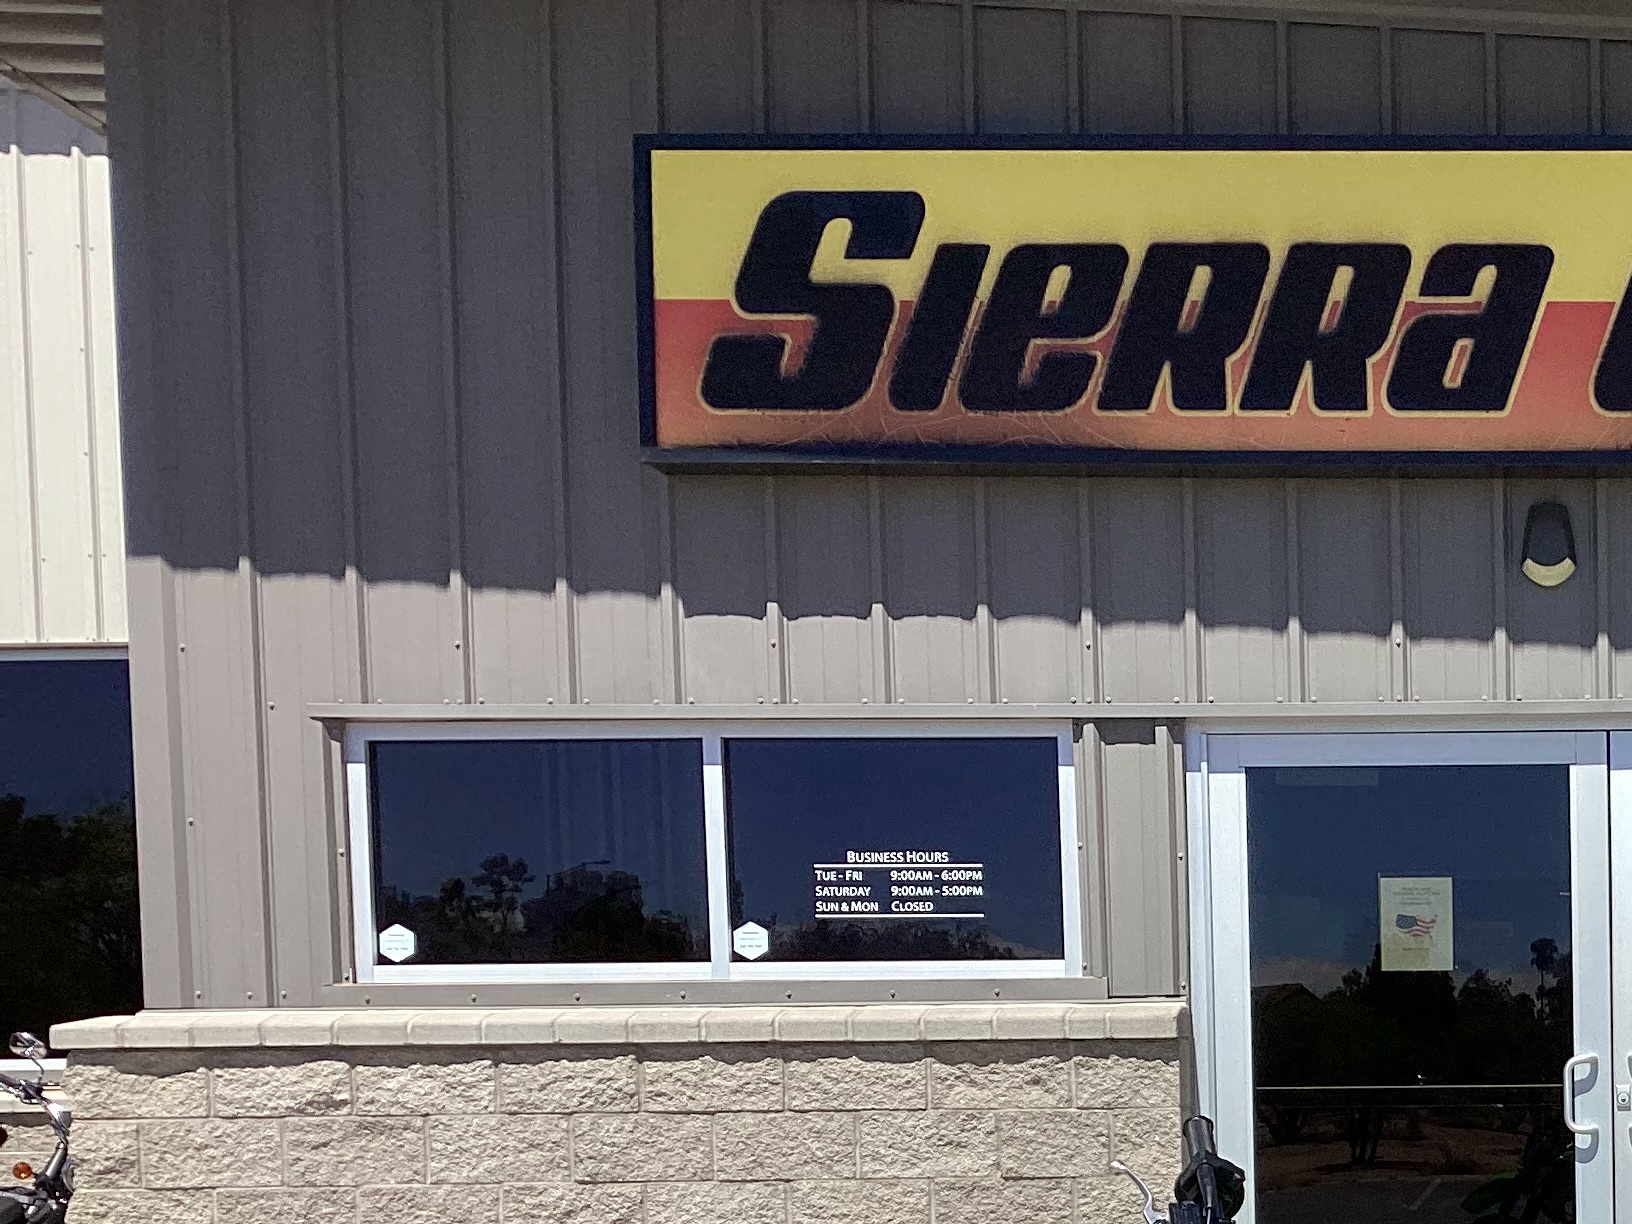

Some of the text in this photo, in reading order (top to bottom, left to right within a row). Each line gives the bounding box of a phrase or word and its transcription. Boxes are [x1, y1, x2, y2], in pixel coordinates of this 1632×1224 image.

[846, 851, 949, 863] BUSINESS HOURS
[815, 870, 837, 881] TUE
[845, 870, 863, 881] FRI
[890, 870, 933, 881] 9:00AM
[941, 870, 983, 881] 6:00PM
[815, 886, 871, 897] SATURDAY
[891, 886, 933, 896] 9:00AM
[941, 885, 983, 896] 5:00PM
[815, 901, 934, 912] SUN & MON CLOSED
